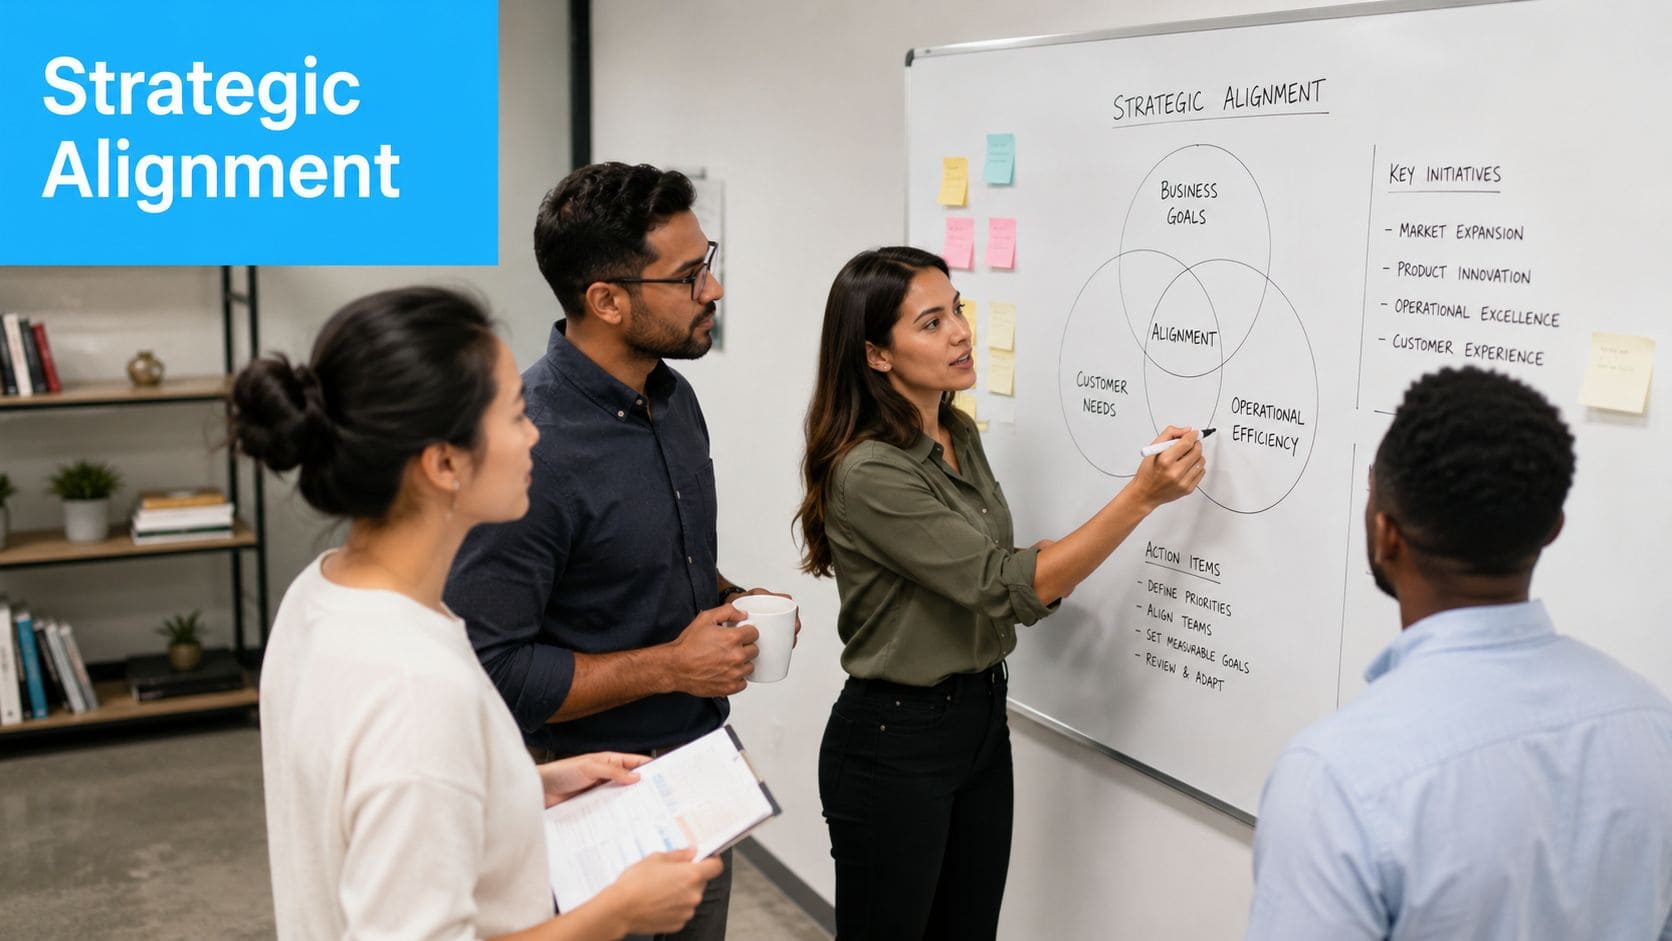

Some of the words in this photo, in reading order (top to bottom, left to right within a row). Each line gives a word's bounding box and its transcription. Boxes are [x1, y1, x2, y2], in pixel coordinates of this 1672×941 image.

[1113, 90, 1204, 120] STRATEGIC
[1223, 79, 1327, 110] ALIGNMENT
[1389, 163, 1415, 185] KEY
[1426, 165, 1501, 183] INITIATIVES
[1161, 180, 1218, 200] BUSINESS
[1167, 207, 1207, 225] GOALS
[1399, 223, 1447, 239] MARKET
[1456, 224, 1524, 241] EXPANSION
[1398, 261, 1447, 279] PRODUCT
[1458, 266, 1531, 284] INNOVATION
[1395, 299, 1470, 319] OPERATIONAL
[1481, 306, 1560, 328] EXCELLENCE
[1151, 322, 1217, 347] ALIGNMENT
[1393, 334, 1453, 354] CUSTOMER
[1465, 343, 1544, 366] EXPERIENCE
[1076, 371, 1128, 395] CUSTOMER
[1083, 398, 1117, 417] NEEDS
[1231, 397, 1305, 425] OPERATIONAL
[1232, 425, 1299, 457] EFFICIENCY
[1145, 541, 1180, 564] ACTION
[1189, 555, 1221, 576] ITEMS
[1148, 579, 1177, 599] DEFINE
[1186, 591, 1232, 616] PRIORITIES
[1147, 604, 1173, 622] ALIGN
[1182, 616, 1212, 636] TEAMS
[1146, 629, 1162, 643] SET
[1167, 636, 1215, 662] MEASURABLE
[1222, 654, 1250, 674] GOALS
[1146, 652, 1176, 673] REVIEW
[1183, 666, 1190, 679] &
[1196, 671, 1224, 692] ADAPT
